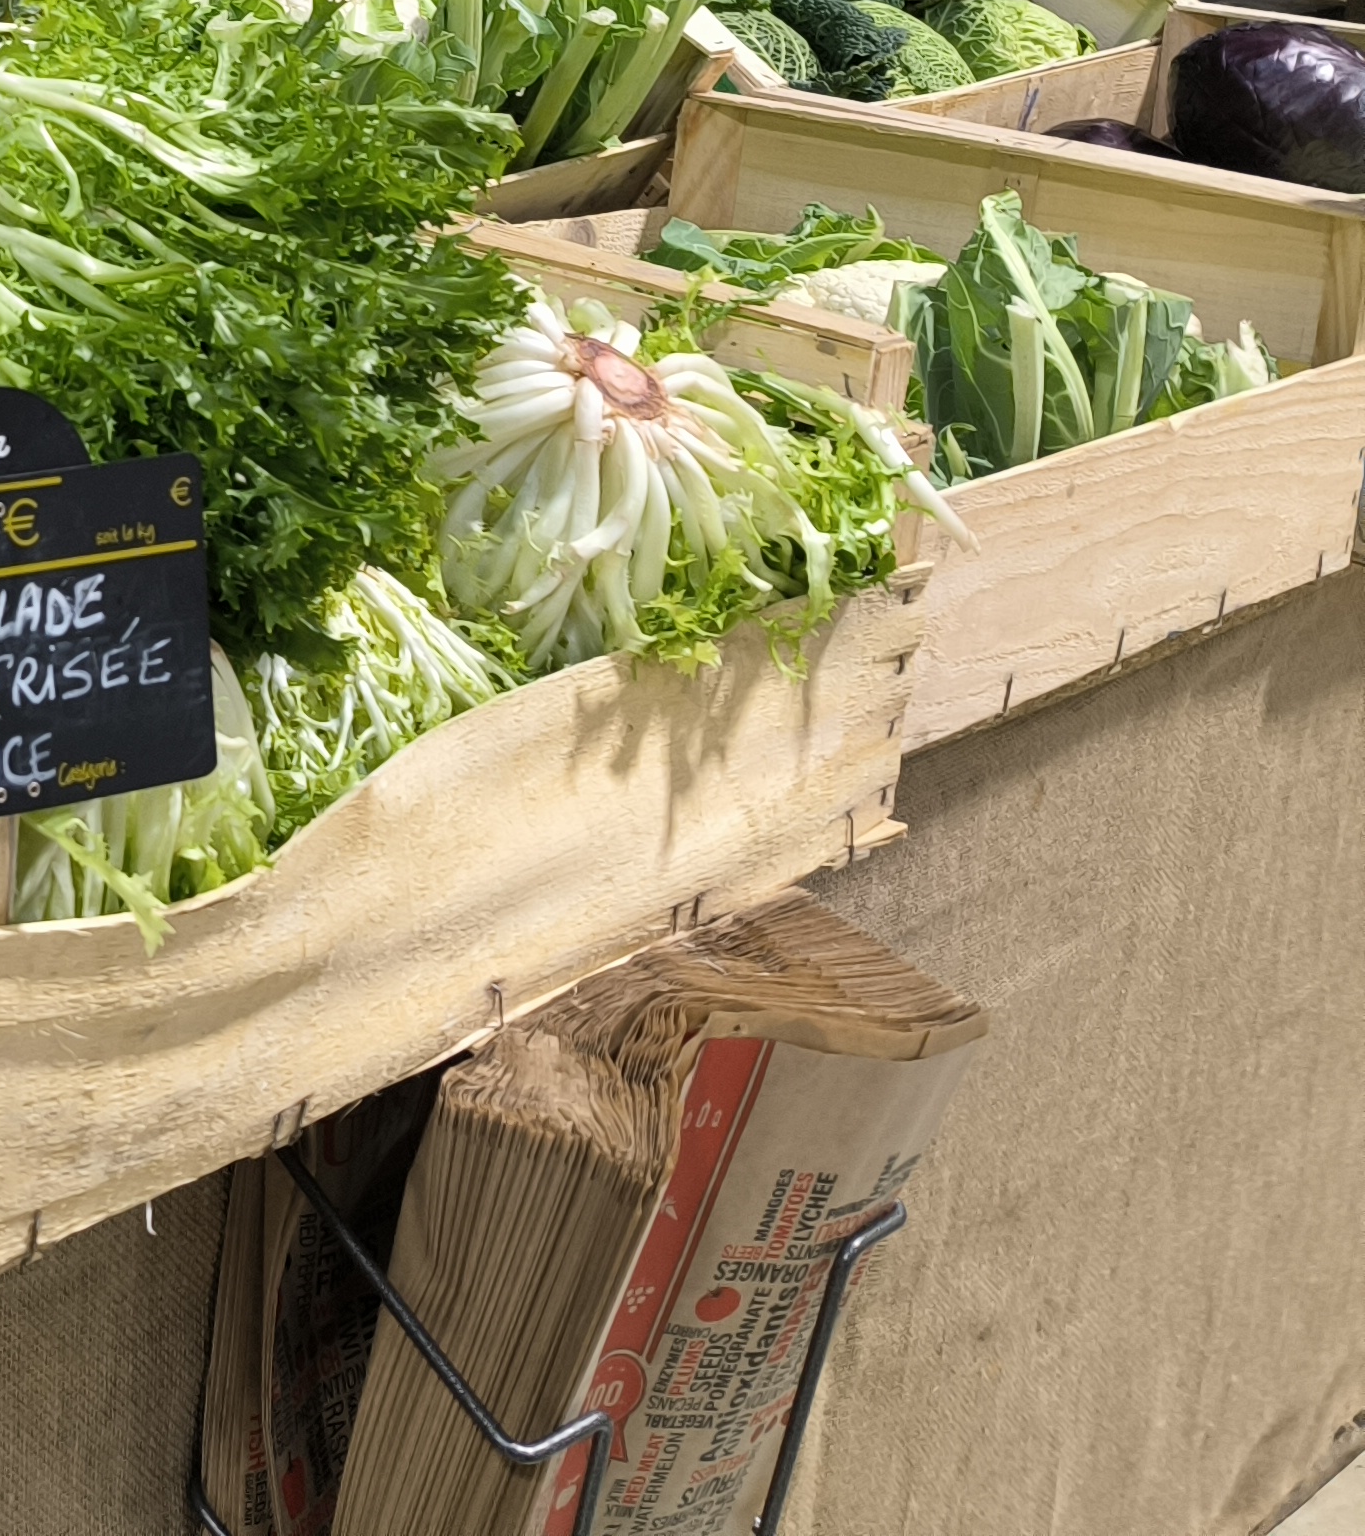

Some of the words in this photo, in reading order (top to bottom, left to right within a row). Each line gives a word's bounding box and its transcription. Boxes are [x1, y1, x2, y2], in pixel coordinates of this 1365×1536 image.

[3, 498, 40, 546] €
[170, 477, 192, 506] €
[299, 1213, 316, 1247] RED
[754, 1168, 795, 1241] MANGOES
[764, 1172, 814, 1260] TOMATOES
[794, 1172, 838, 1242] LYCHEE
[714, 1261, 810, 1283] ORANGES
[722, 1243, 763, 1260] BEETS
[652, 1338, 687, 1394] ENZYMES
[670, 1340, 706, 1397] PLUMS
[690, 1332, 732, 1393] SEEDS
[699, 1286, 799, 1462] Antioxidants
[704, 1287, 772, 1411] POMEGRANATE
[646, 1395, 703, 1411] PECANS
[622, 1476, 646, 1506] RED
[637, 1432, 665, 1472] MEAT
[628, 1432, 685, 1536] WATERMELON
